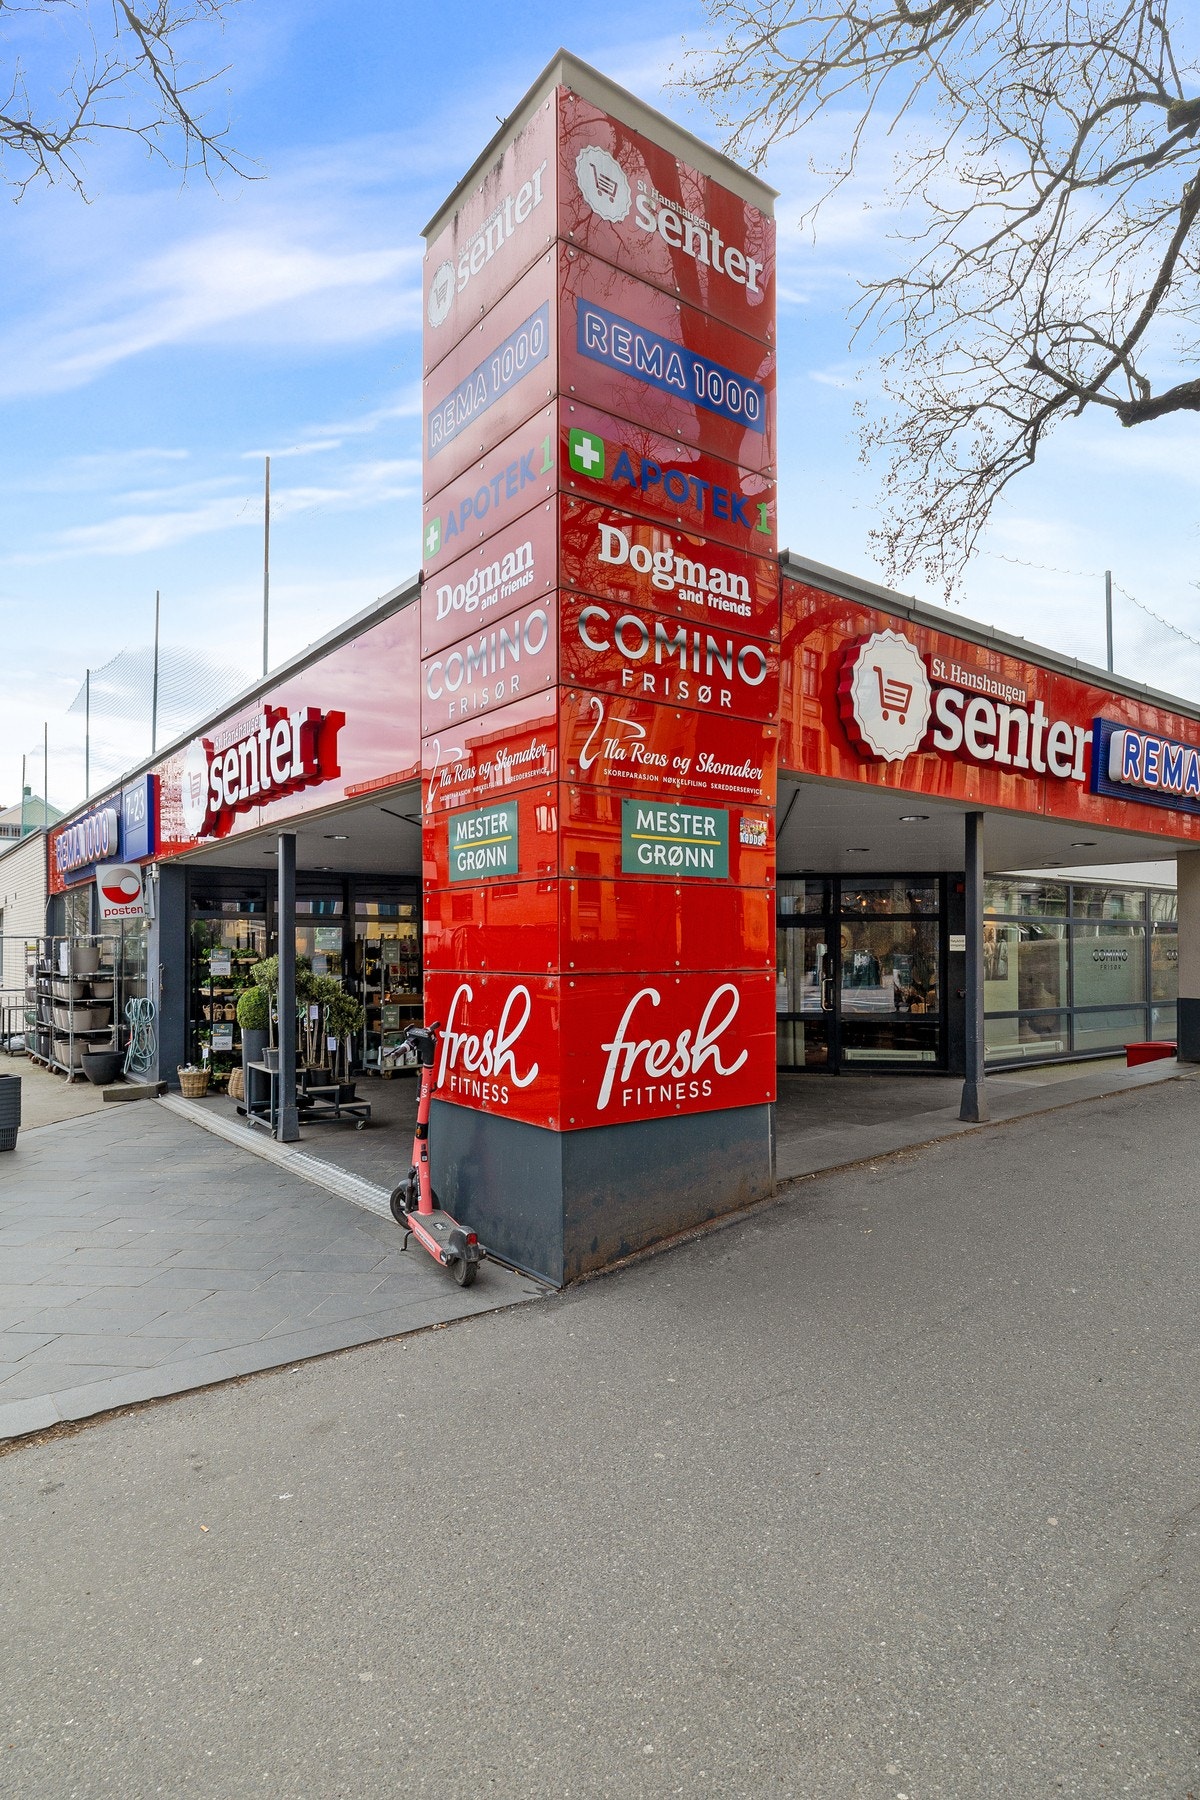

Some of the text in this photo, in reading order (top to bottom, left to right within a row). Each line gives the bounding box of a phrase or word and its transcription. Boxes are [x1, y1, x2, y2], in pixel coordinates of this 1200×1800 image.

[457, 158, 547, 293] senter
[651, 186, 711, 231] Hanshaugen
[635, 194, 763, 293] senter
[431, 319, 544, 447] REMA 1000
[584, 312, 759, 420] REMA 1000
[444, 434, 556, 544] APOTEK 1
[612, 451, 772, 536] APOTEK 1
[436, 541, 535, 621] Dogman
[598, 522, 752, 602] Dogman
[481, 570, 534, 611] and friends
[678, 587, 752, 617] and friends
[426, 609, 549, 700] COMINO
[578, 605, 767, 686] COMINO
[449, 674, 520, 719] FRISØR
[622, 669, 732, 708] FRISØR
[932, 658, 1027, 703] St. Hanshaugen
[222, 714, 261, 747] Hanshauge
[933, 687, 1093, 782] senter
[209, 705, 309, 812] senter
[454, 763, 477, 783] Rens
[479, 762, 492, 780] og
[495, 738, 548, 771] Skomaker
[631, 742, 669, 767] Rens
[672, 756, 692, 775] og
[696, 752, 763, 781] Skomaker
[1122, 729, 1200, 796] REMA
[603, 768, 763, 796] SKOREPARASJON NØKKELFILING SKREDDERSERVICE
[126, 788, 145, 826] 7-23
[456, 812, 509, 842] MESTER
[636, 809, 717, 837] MESTER
[56, 808, 110, 874] REMA 1000
[457, 845, 508, 872] GRØNN
[637, 844, 715, 868] GRØNN
[104, 905, 144, 918] posten
[1093, 949, 1128, 961] COMINO
[437, 983, 539, 1089] fresh
[597, 983, 748, 1110] fresh
[450, 1076, 509, 1105] FITNESS
[622, 1079, 712, 1107] FITNESS
